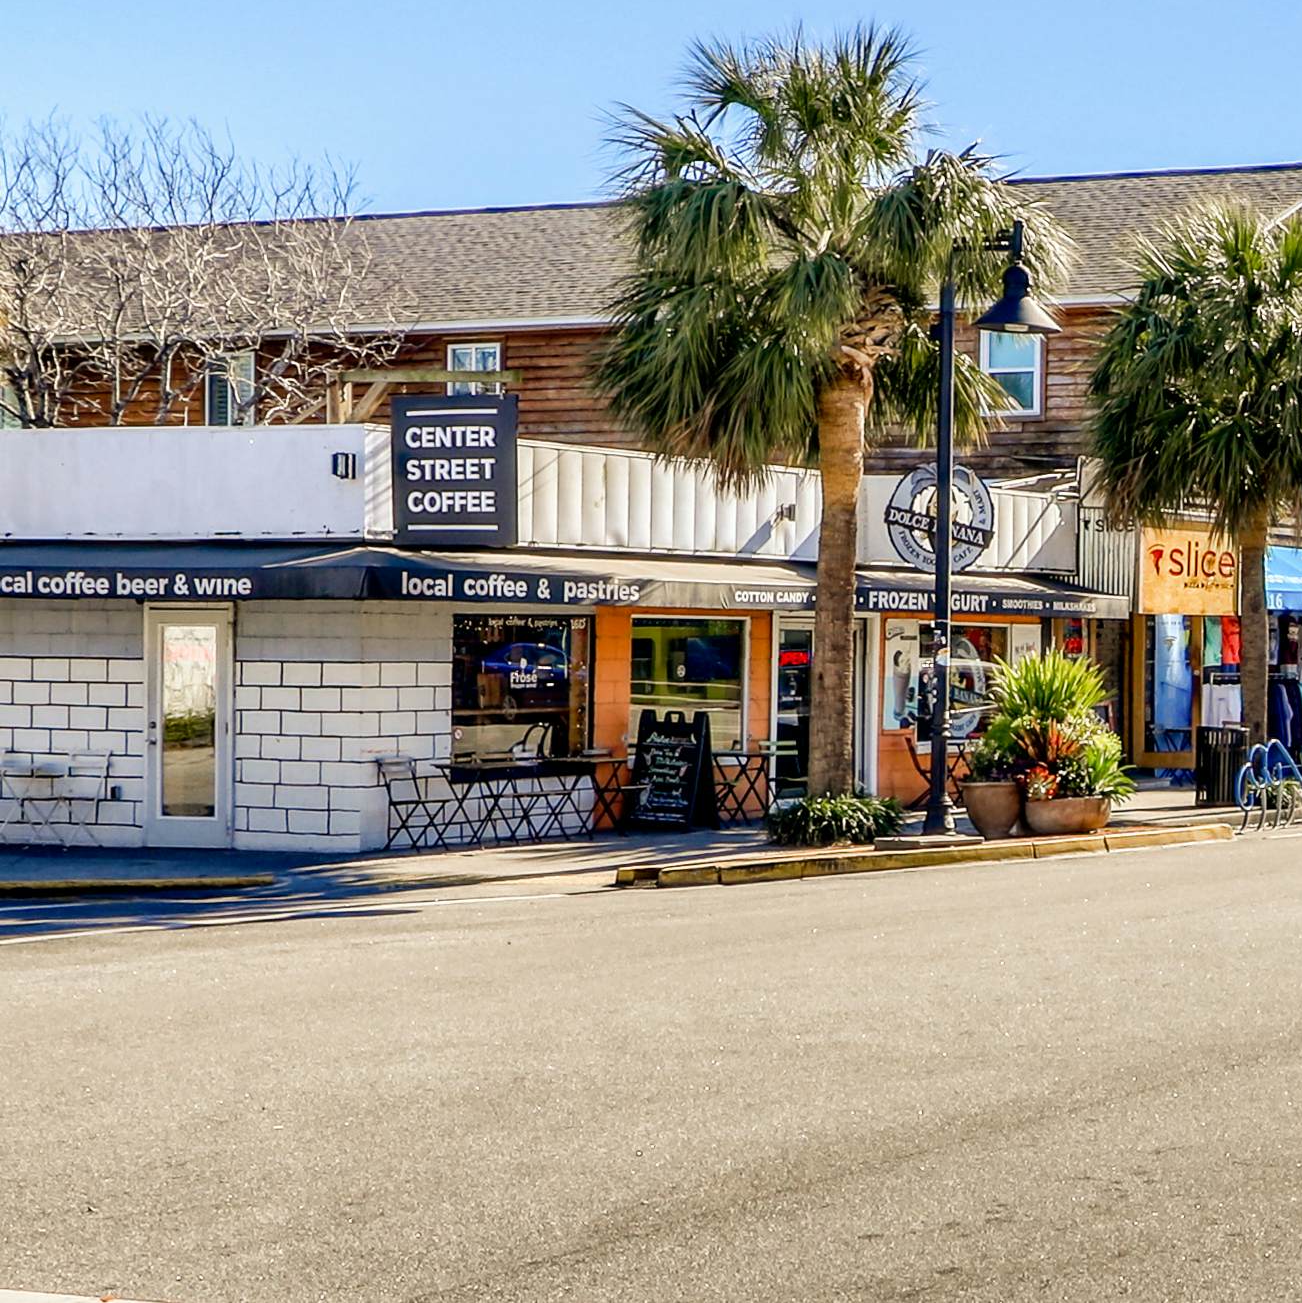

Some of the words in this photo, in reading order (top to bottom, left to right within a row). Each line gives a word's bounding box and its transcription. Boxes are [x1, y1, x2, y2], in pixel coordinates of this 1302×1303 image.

[405, 426, 496, 448] CENTER
[406, 458, 496, 480] STREET
[407, 491, 496, 513] COFFEE
[889, 510, 930, 529] DOLCE
[1095, 515, 1136, 533] slice
[1169, 541, 1236, 578] slice
[37, 571, 110, 595] coffee
[116, 573, 169, 595] beer
[173, 573, 190, 595] &
[194, 577, 252, 595] wine
[401, 571, 454, 597] local
[463, 574, 529, 598] coffee
[537, 578, 551, 599] &
[563, 579, 641, 603] pastries
[735, 591, 775, 603] COTTON
[776, 592, 810, 603] CANDY
[868, 591, 929, 611] FROZEN
[1001, 599, 1044, 610] SMOOTHIES
[1052, 601, 1097, 612] MILKSHAKES
